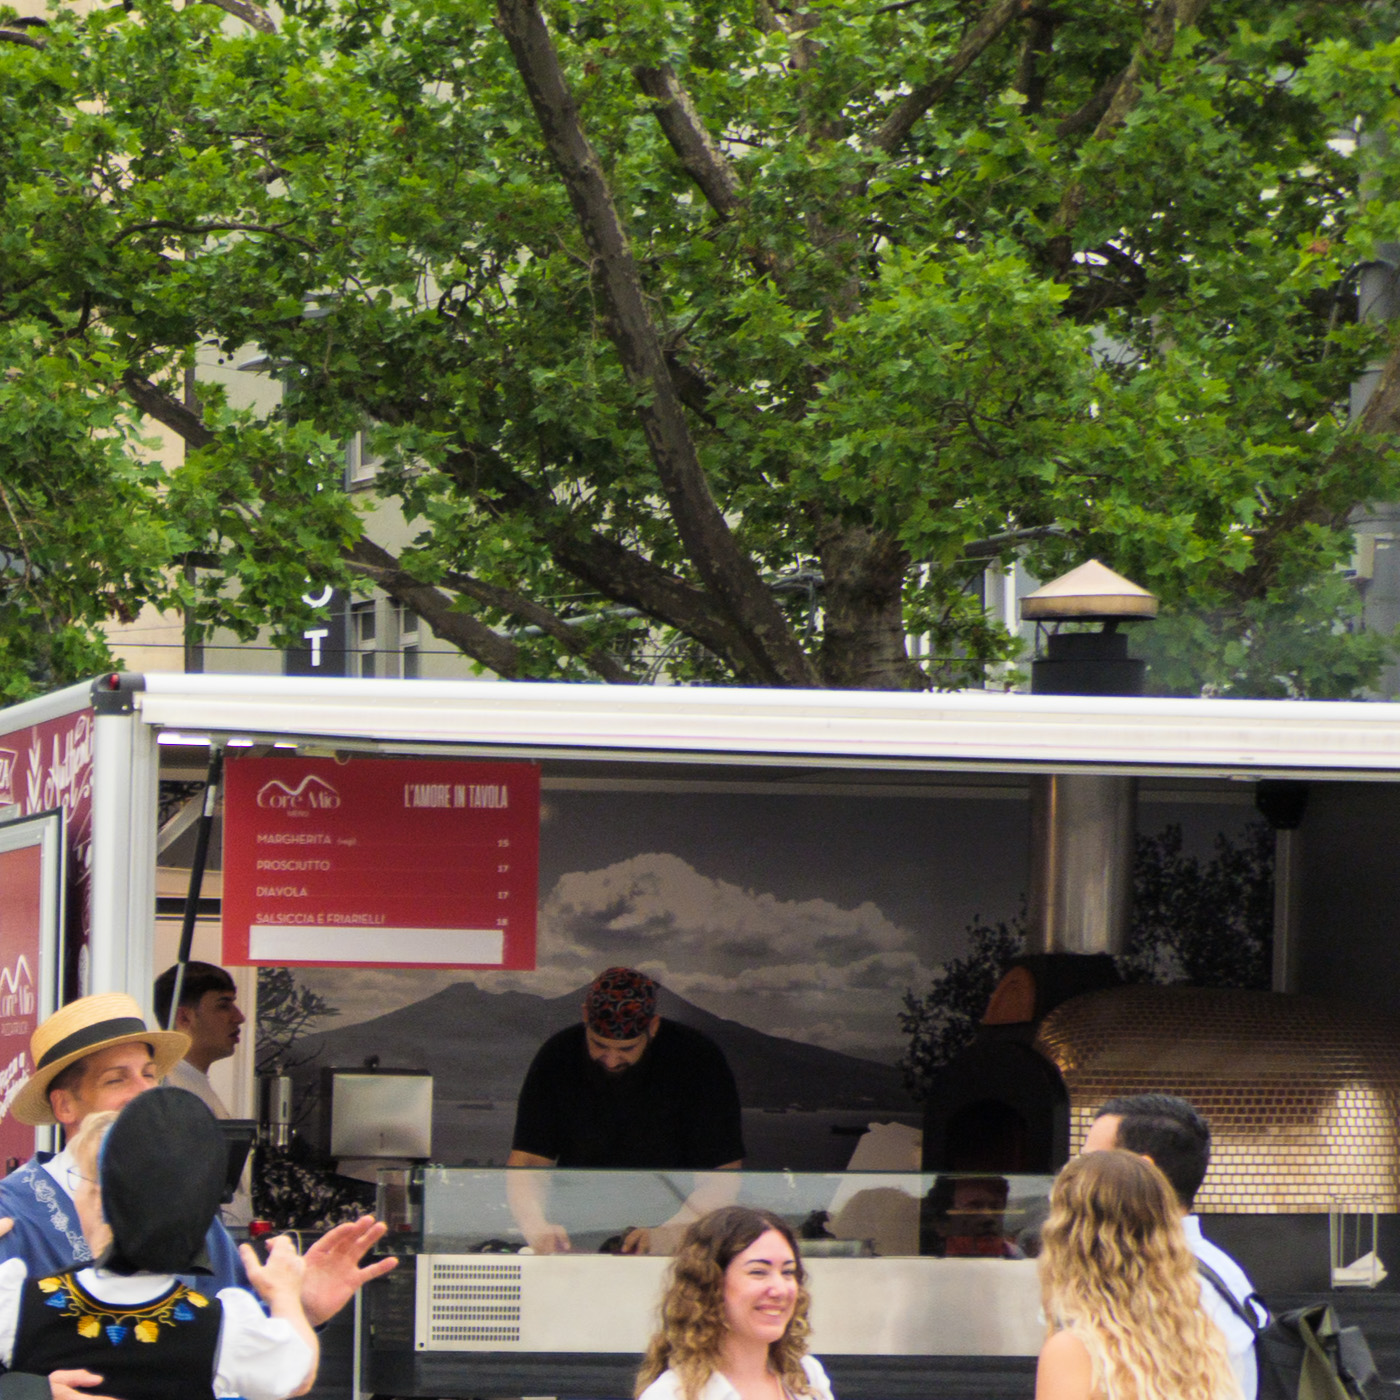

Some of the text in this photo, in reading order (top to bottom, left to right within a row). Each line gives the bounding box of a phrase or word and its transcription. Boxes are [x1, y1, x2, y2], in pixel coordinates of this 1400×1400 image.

[257, 834, 332, 845] MARGHERITA
[256, 860, 331, 871] PROSCIUTTO
[256, 886, 308, 898] DIAVOLA
[256, 913, 315, 924] SALSICCIA
